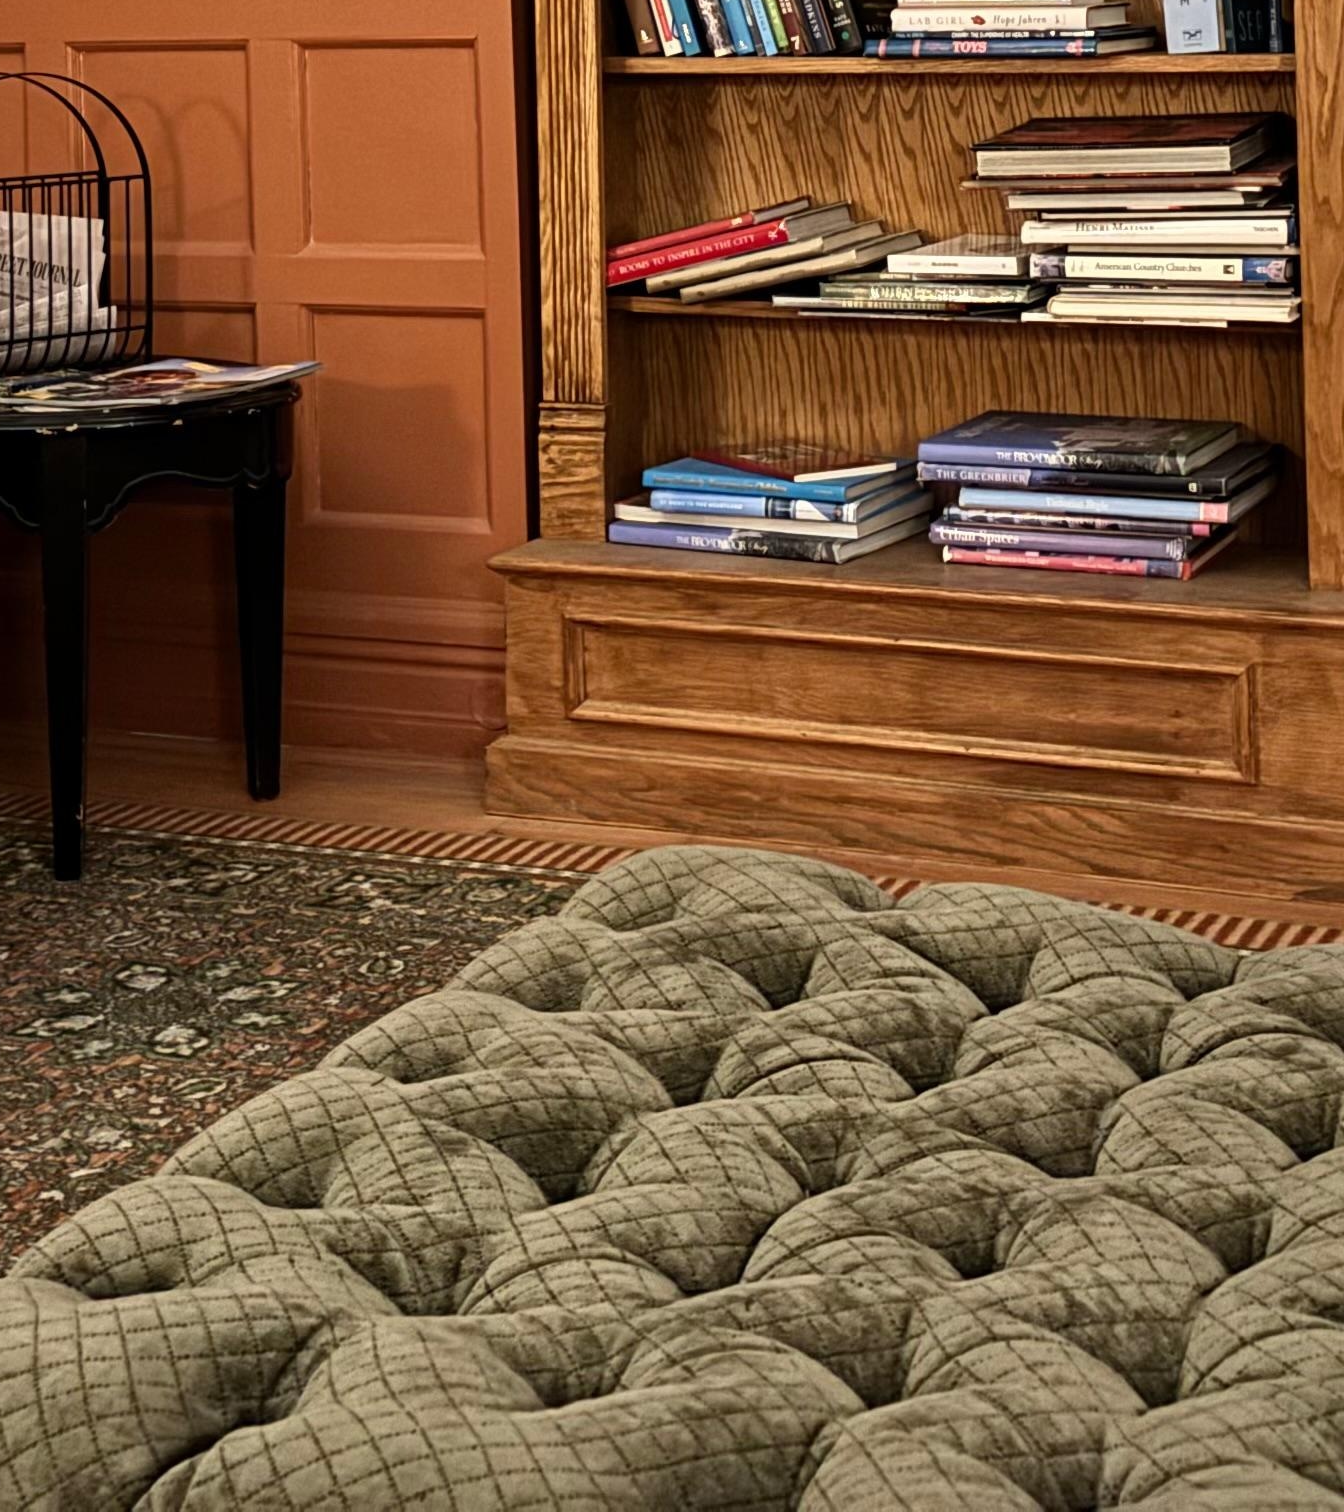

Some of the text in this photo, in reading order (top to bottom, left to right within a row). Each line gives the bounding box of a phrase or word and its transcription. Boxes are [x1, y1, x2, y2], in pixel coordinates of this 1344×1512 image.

[908, 16, 964, 25] LAB GIRL
[992, 14, 1047, 25] Hope Jahren
[952, 40, 987, 53] TOYS
[1075, 221, 1109, 233] HENRI
[618, 233, 755, 274] ROOMS TO INSPIRE IN THE CITY
[1094, 261, 1201, 273] American Country Churches
[26, 262, 81, 287] JOURNL
[935, 468, 1026, 484] THE GREENBRIER
[934, 525, 1020, 547] Urban Spaces
